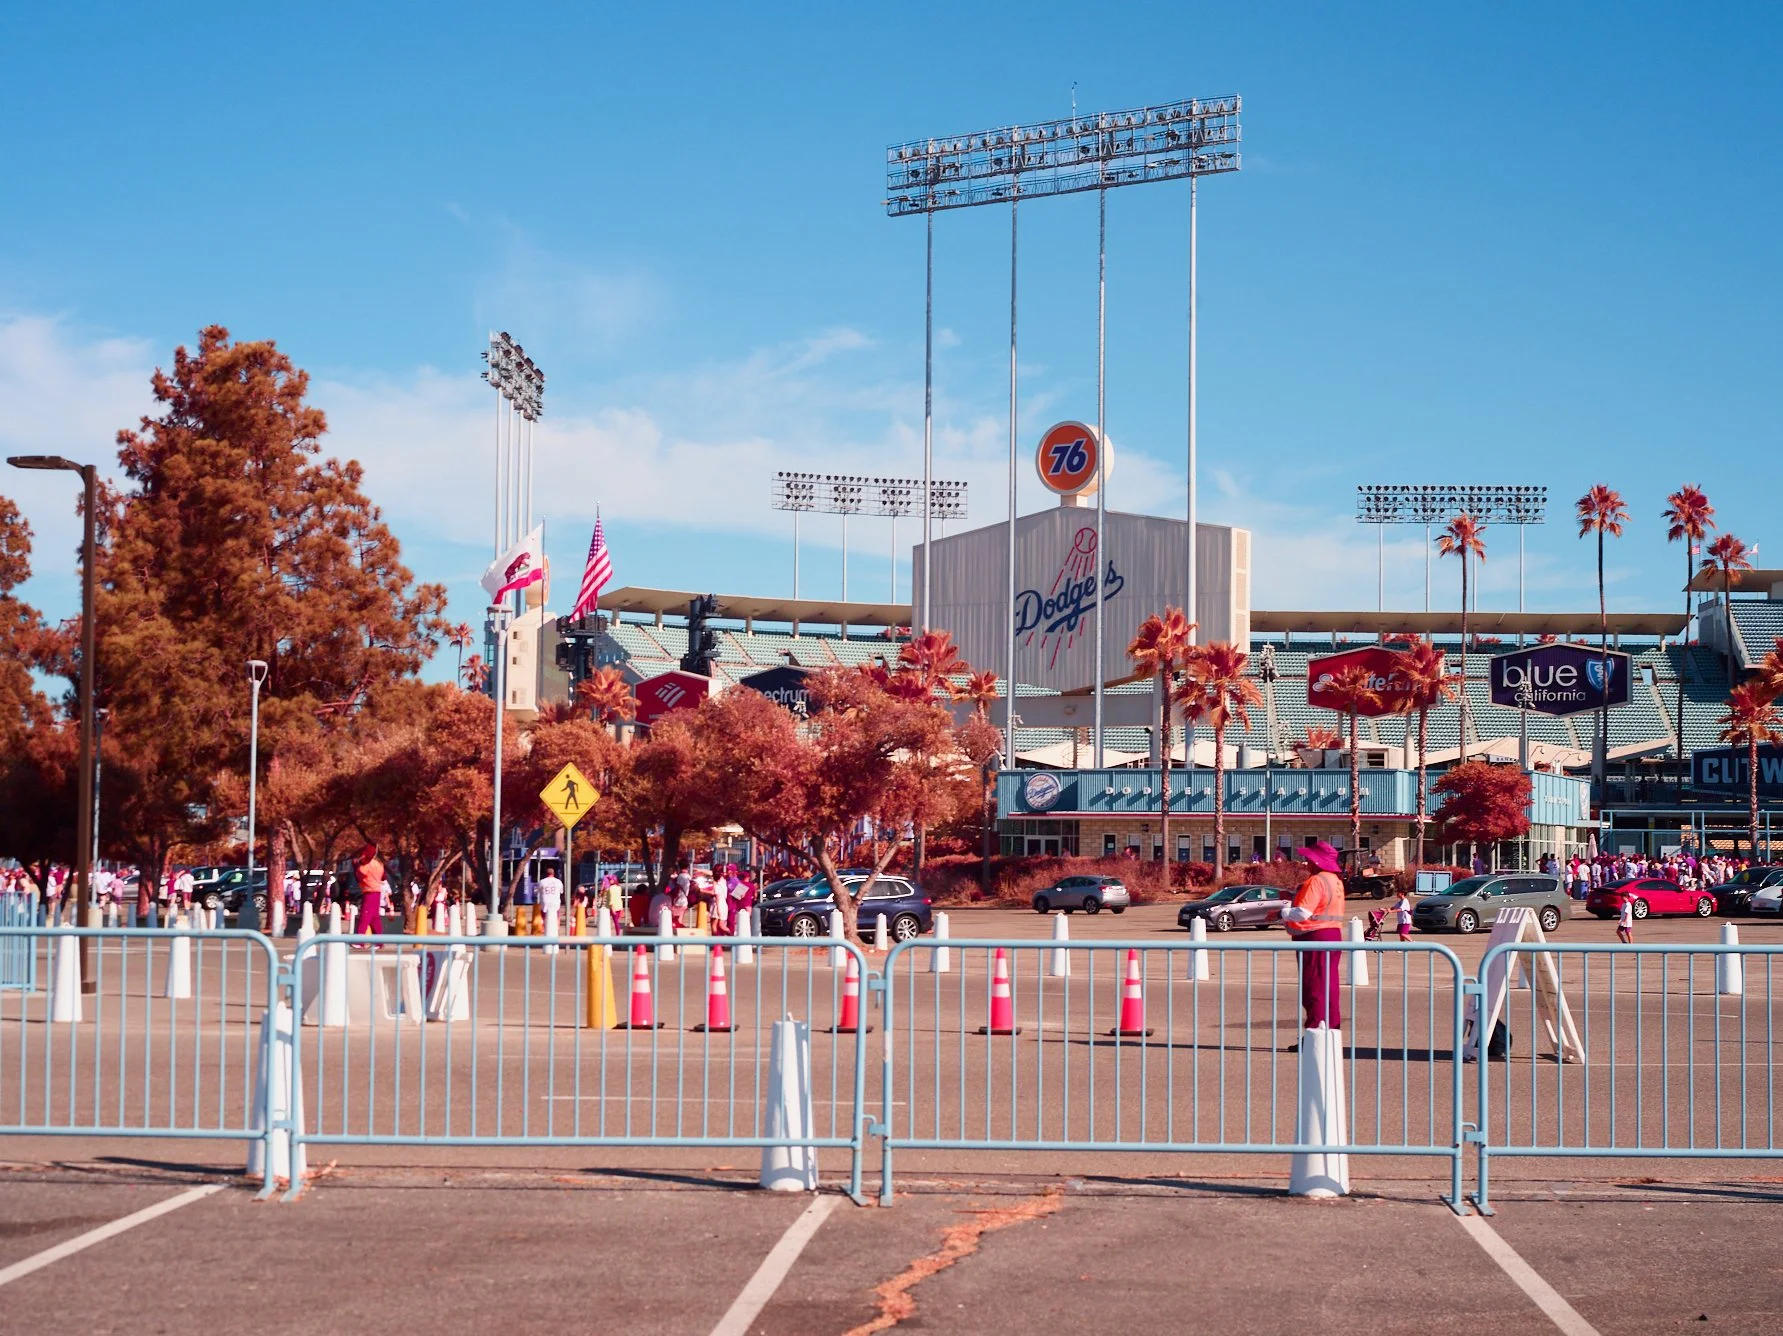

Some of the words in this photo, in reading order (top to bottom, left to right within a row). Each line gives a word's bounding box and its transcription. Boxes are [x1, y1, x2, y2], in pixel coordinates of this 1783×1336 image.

[1049, 438, 1088, 475] 76
[1015, 559, 1125, 637] Dodges
[1502, 658, 1578, 688] blue
[1239, 786, 1370, 796] STADIUM
